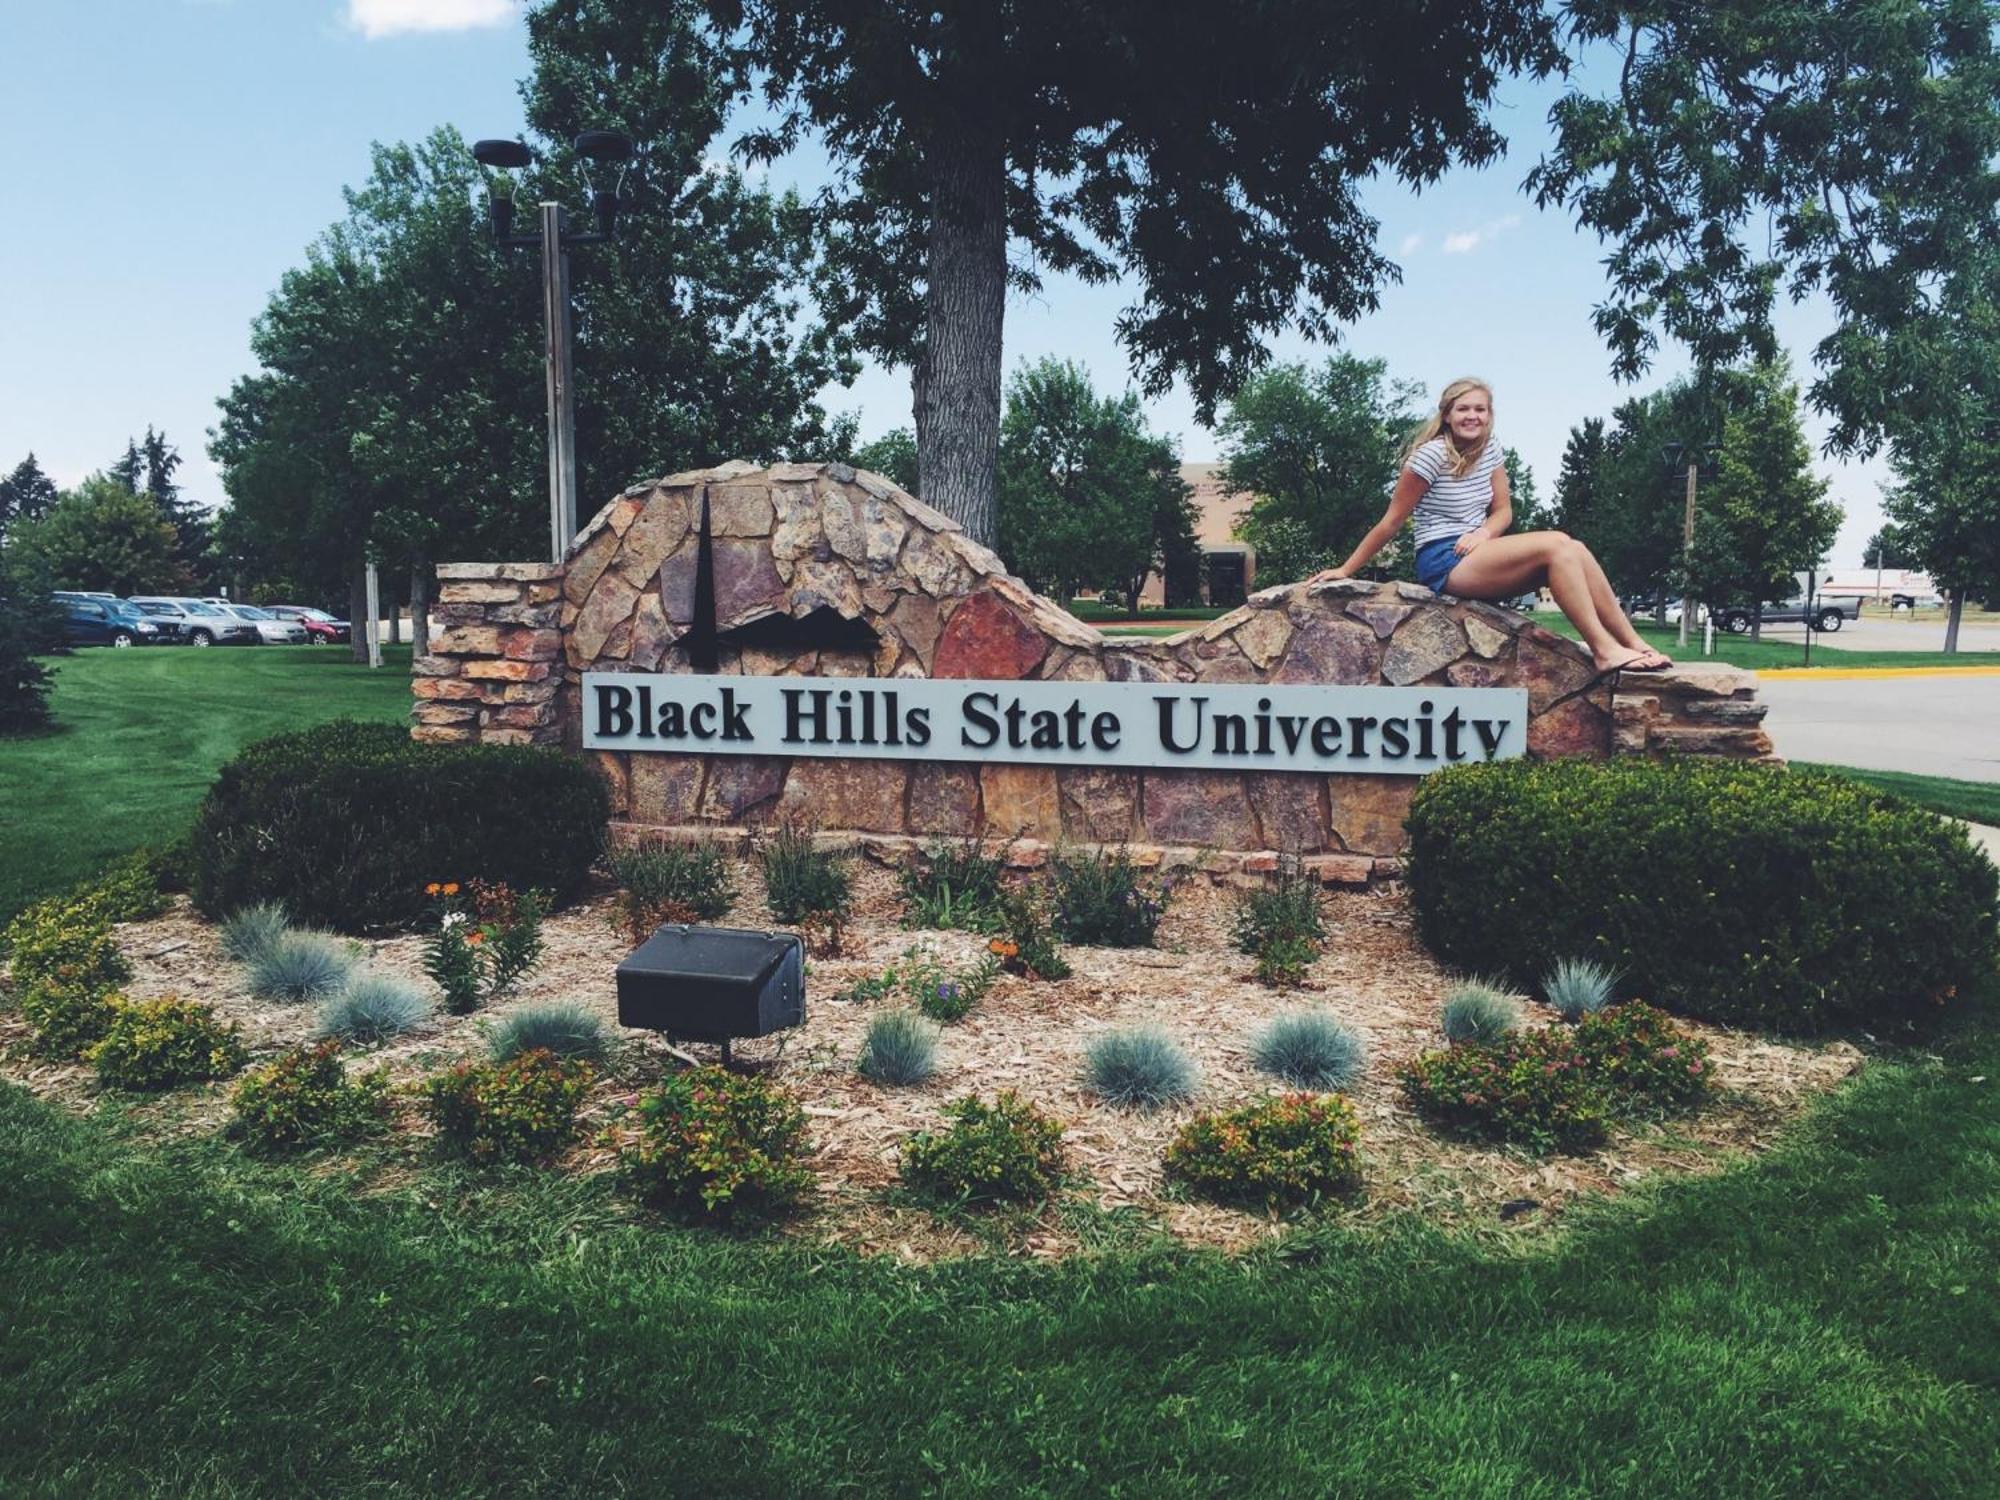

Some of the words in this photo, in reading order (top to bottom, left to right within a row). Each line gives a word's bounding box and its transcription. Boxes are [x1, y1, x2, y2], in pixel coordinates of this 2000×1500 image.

[593, 685, 754, 741] Black
[780, 689, 931, 748] Hills
[961, 692, 1121, 752] State
[1152, 696, 1511, 764] University
